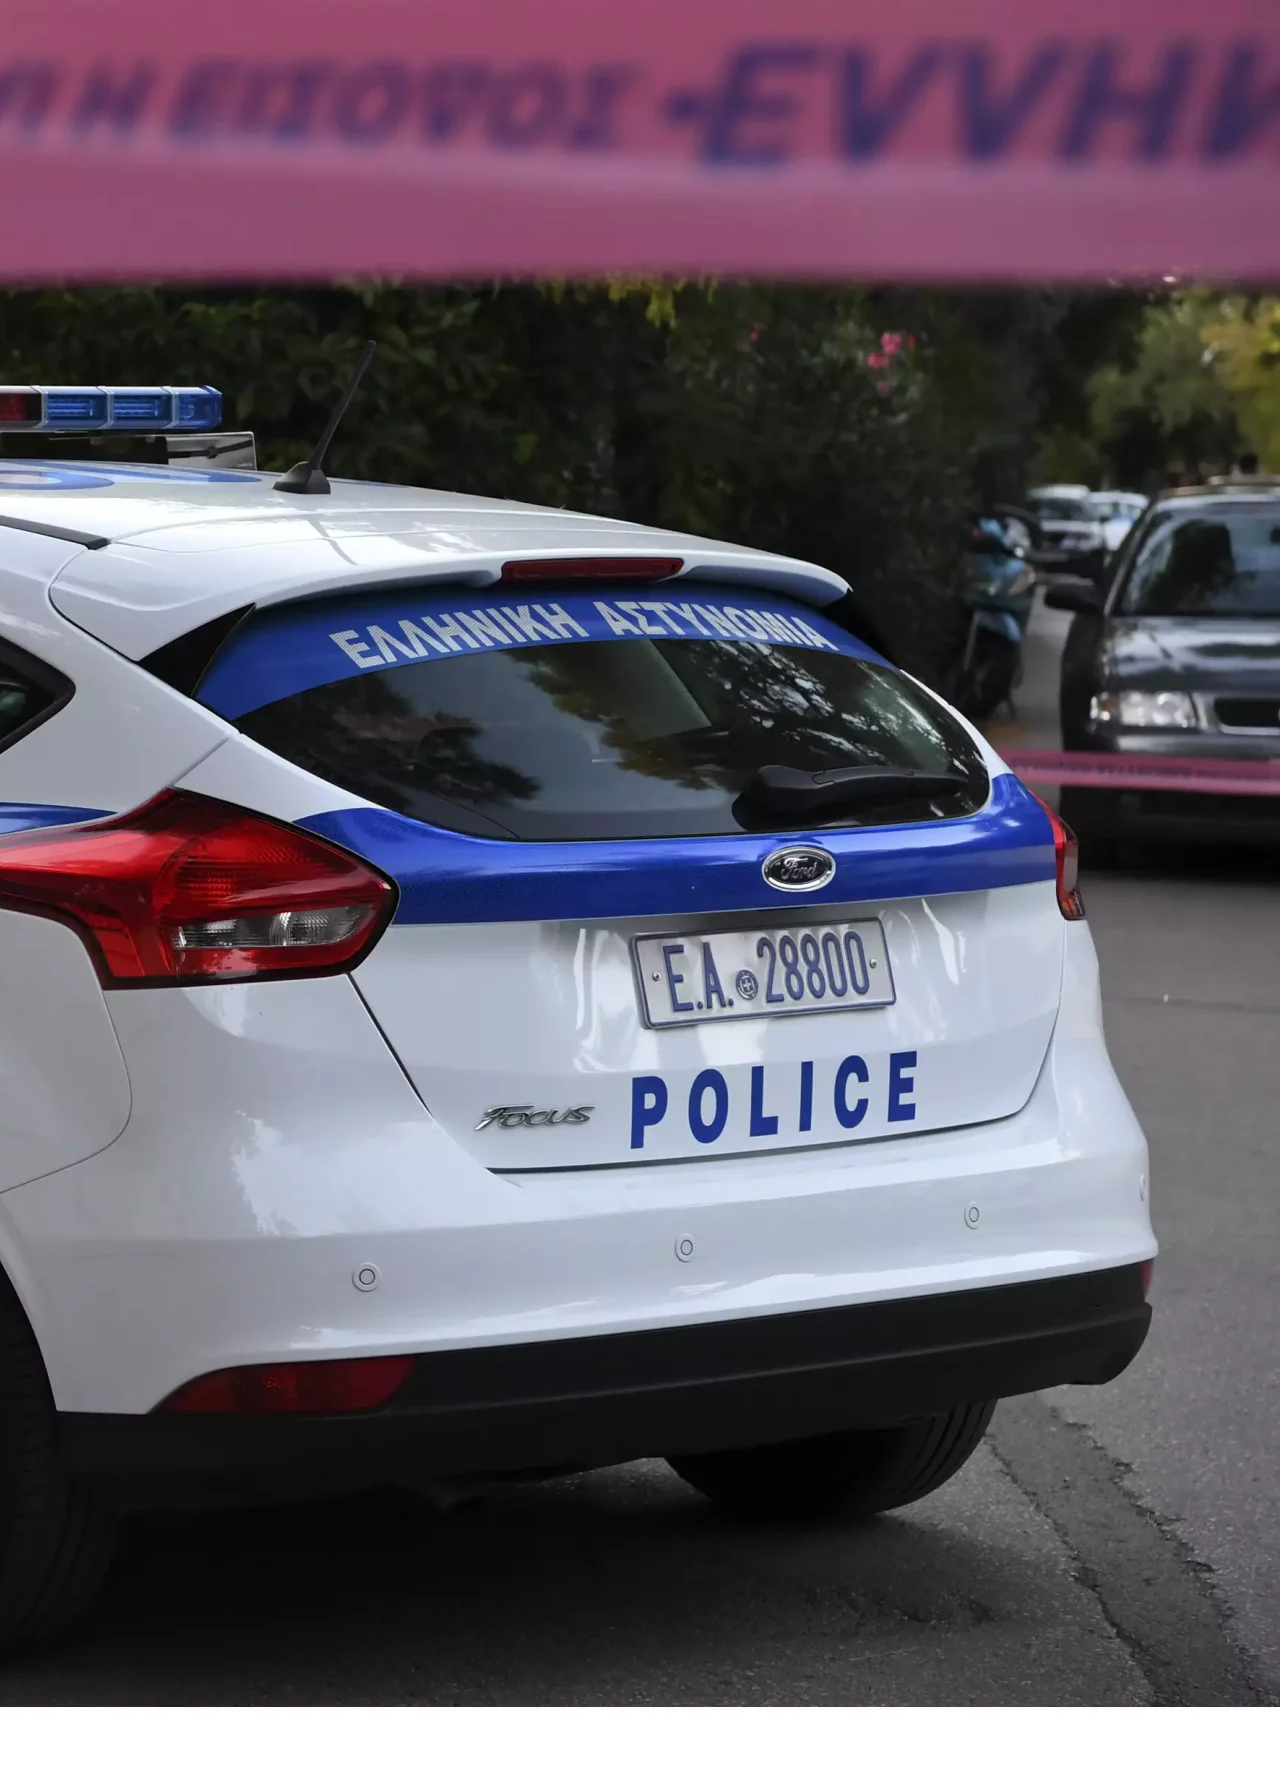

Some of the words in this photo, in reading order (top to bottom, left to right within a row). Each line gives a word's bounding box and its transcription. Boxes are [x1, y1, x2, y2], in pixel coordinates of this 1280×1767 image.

[328, 603, 589, 669] ΕΛΛΗΝΙΚΗ
[593, 601, 840, 652] ΑΣΤΥΝΟΜΙΑ
[780, 857, 818, 880] Ford
[757, 930, 870, 1004] 28800
[630, 1050, 918, 1150] POLICE
